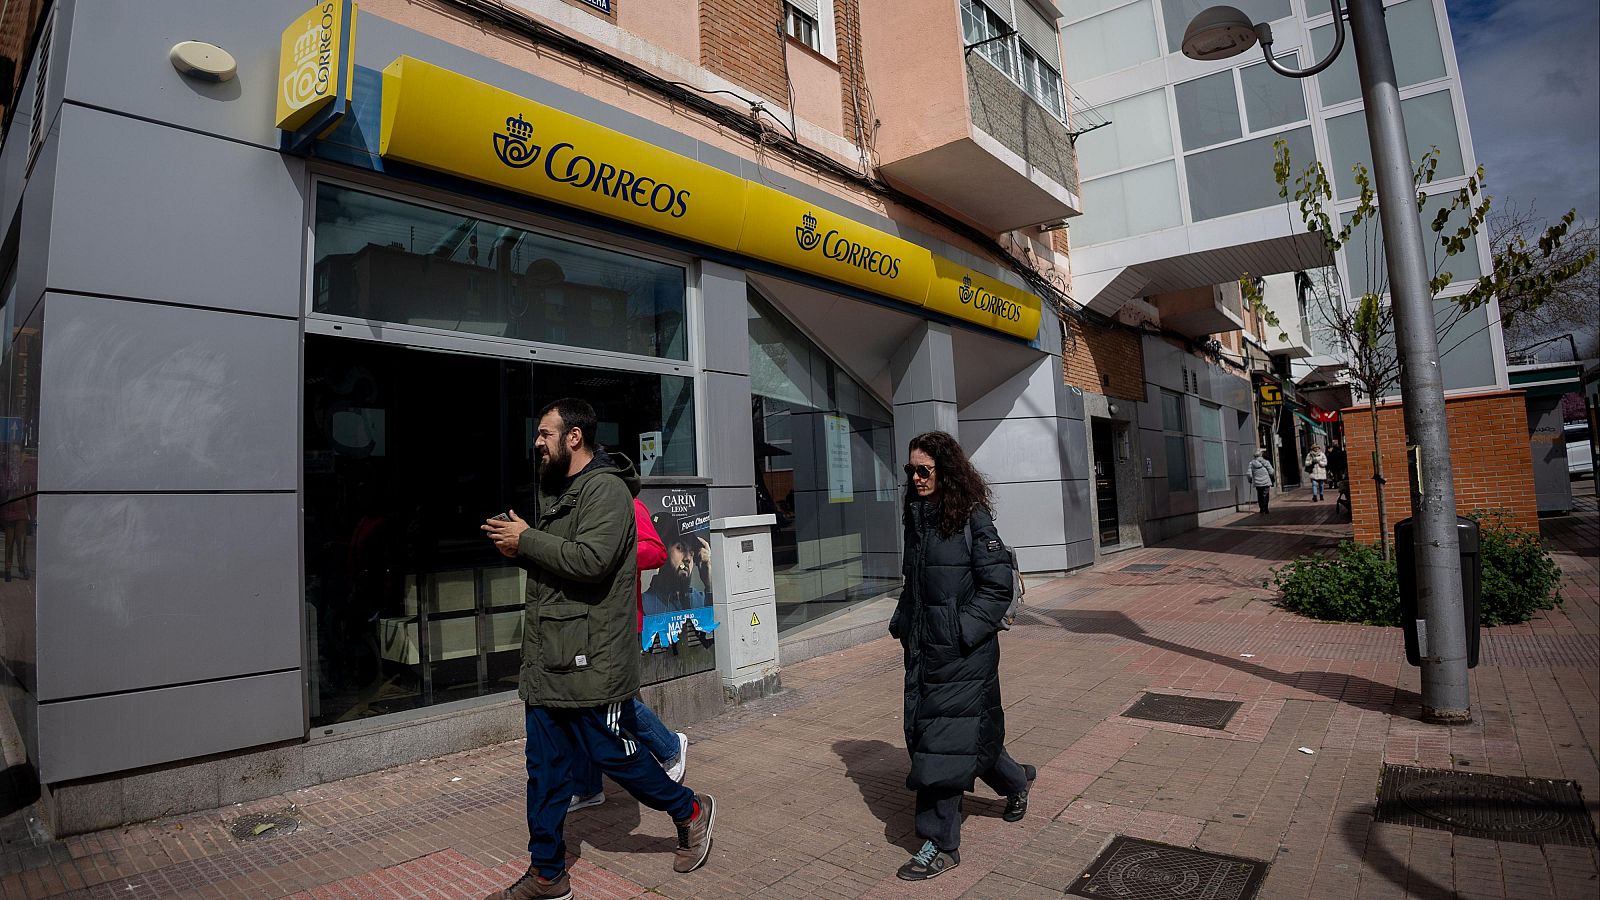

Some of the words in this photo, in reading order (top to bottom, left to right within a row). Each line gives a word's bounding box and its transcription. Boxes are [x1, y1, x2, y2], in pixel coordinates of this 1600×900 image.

[315, 3, 334, 96] CORREOS
[545, 142, 691, 218] CORREOS
[822, 229, 901, 280] CORREOS
[973, 286, 1022, 323] CORREOS
[661, 493, 696, 507] CARÍN
[671, 504, 688, 513] LEÓN
